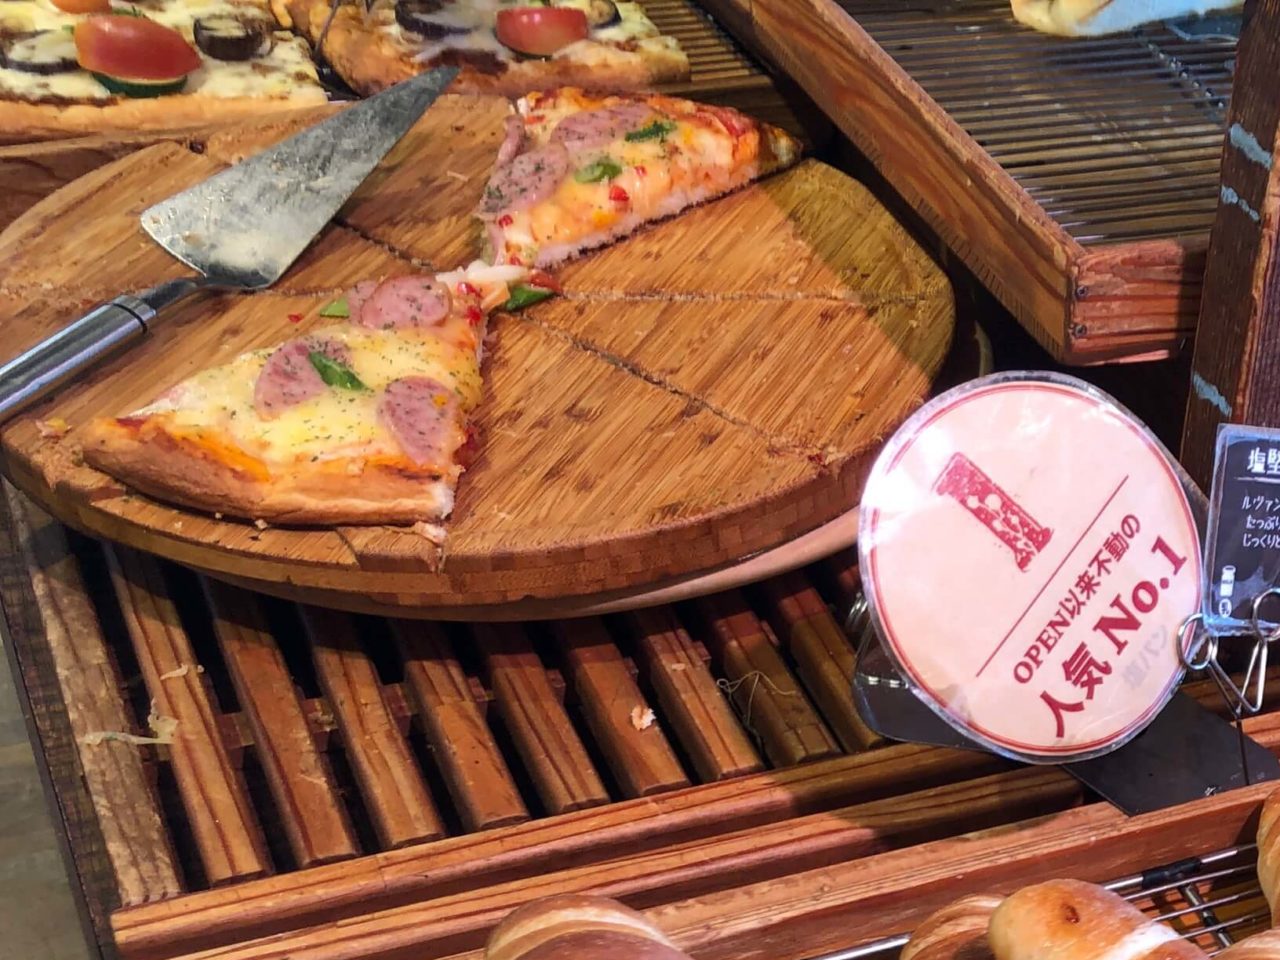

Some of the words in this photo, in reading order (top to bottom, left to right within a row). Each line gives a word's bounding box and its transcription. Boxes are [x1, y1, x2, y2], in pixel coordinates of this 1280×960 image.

[1013, 514, 1141, 684] OPEN以来不動の
